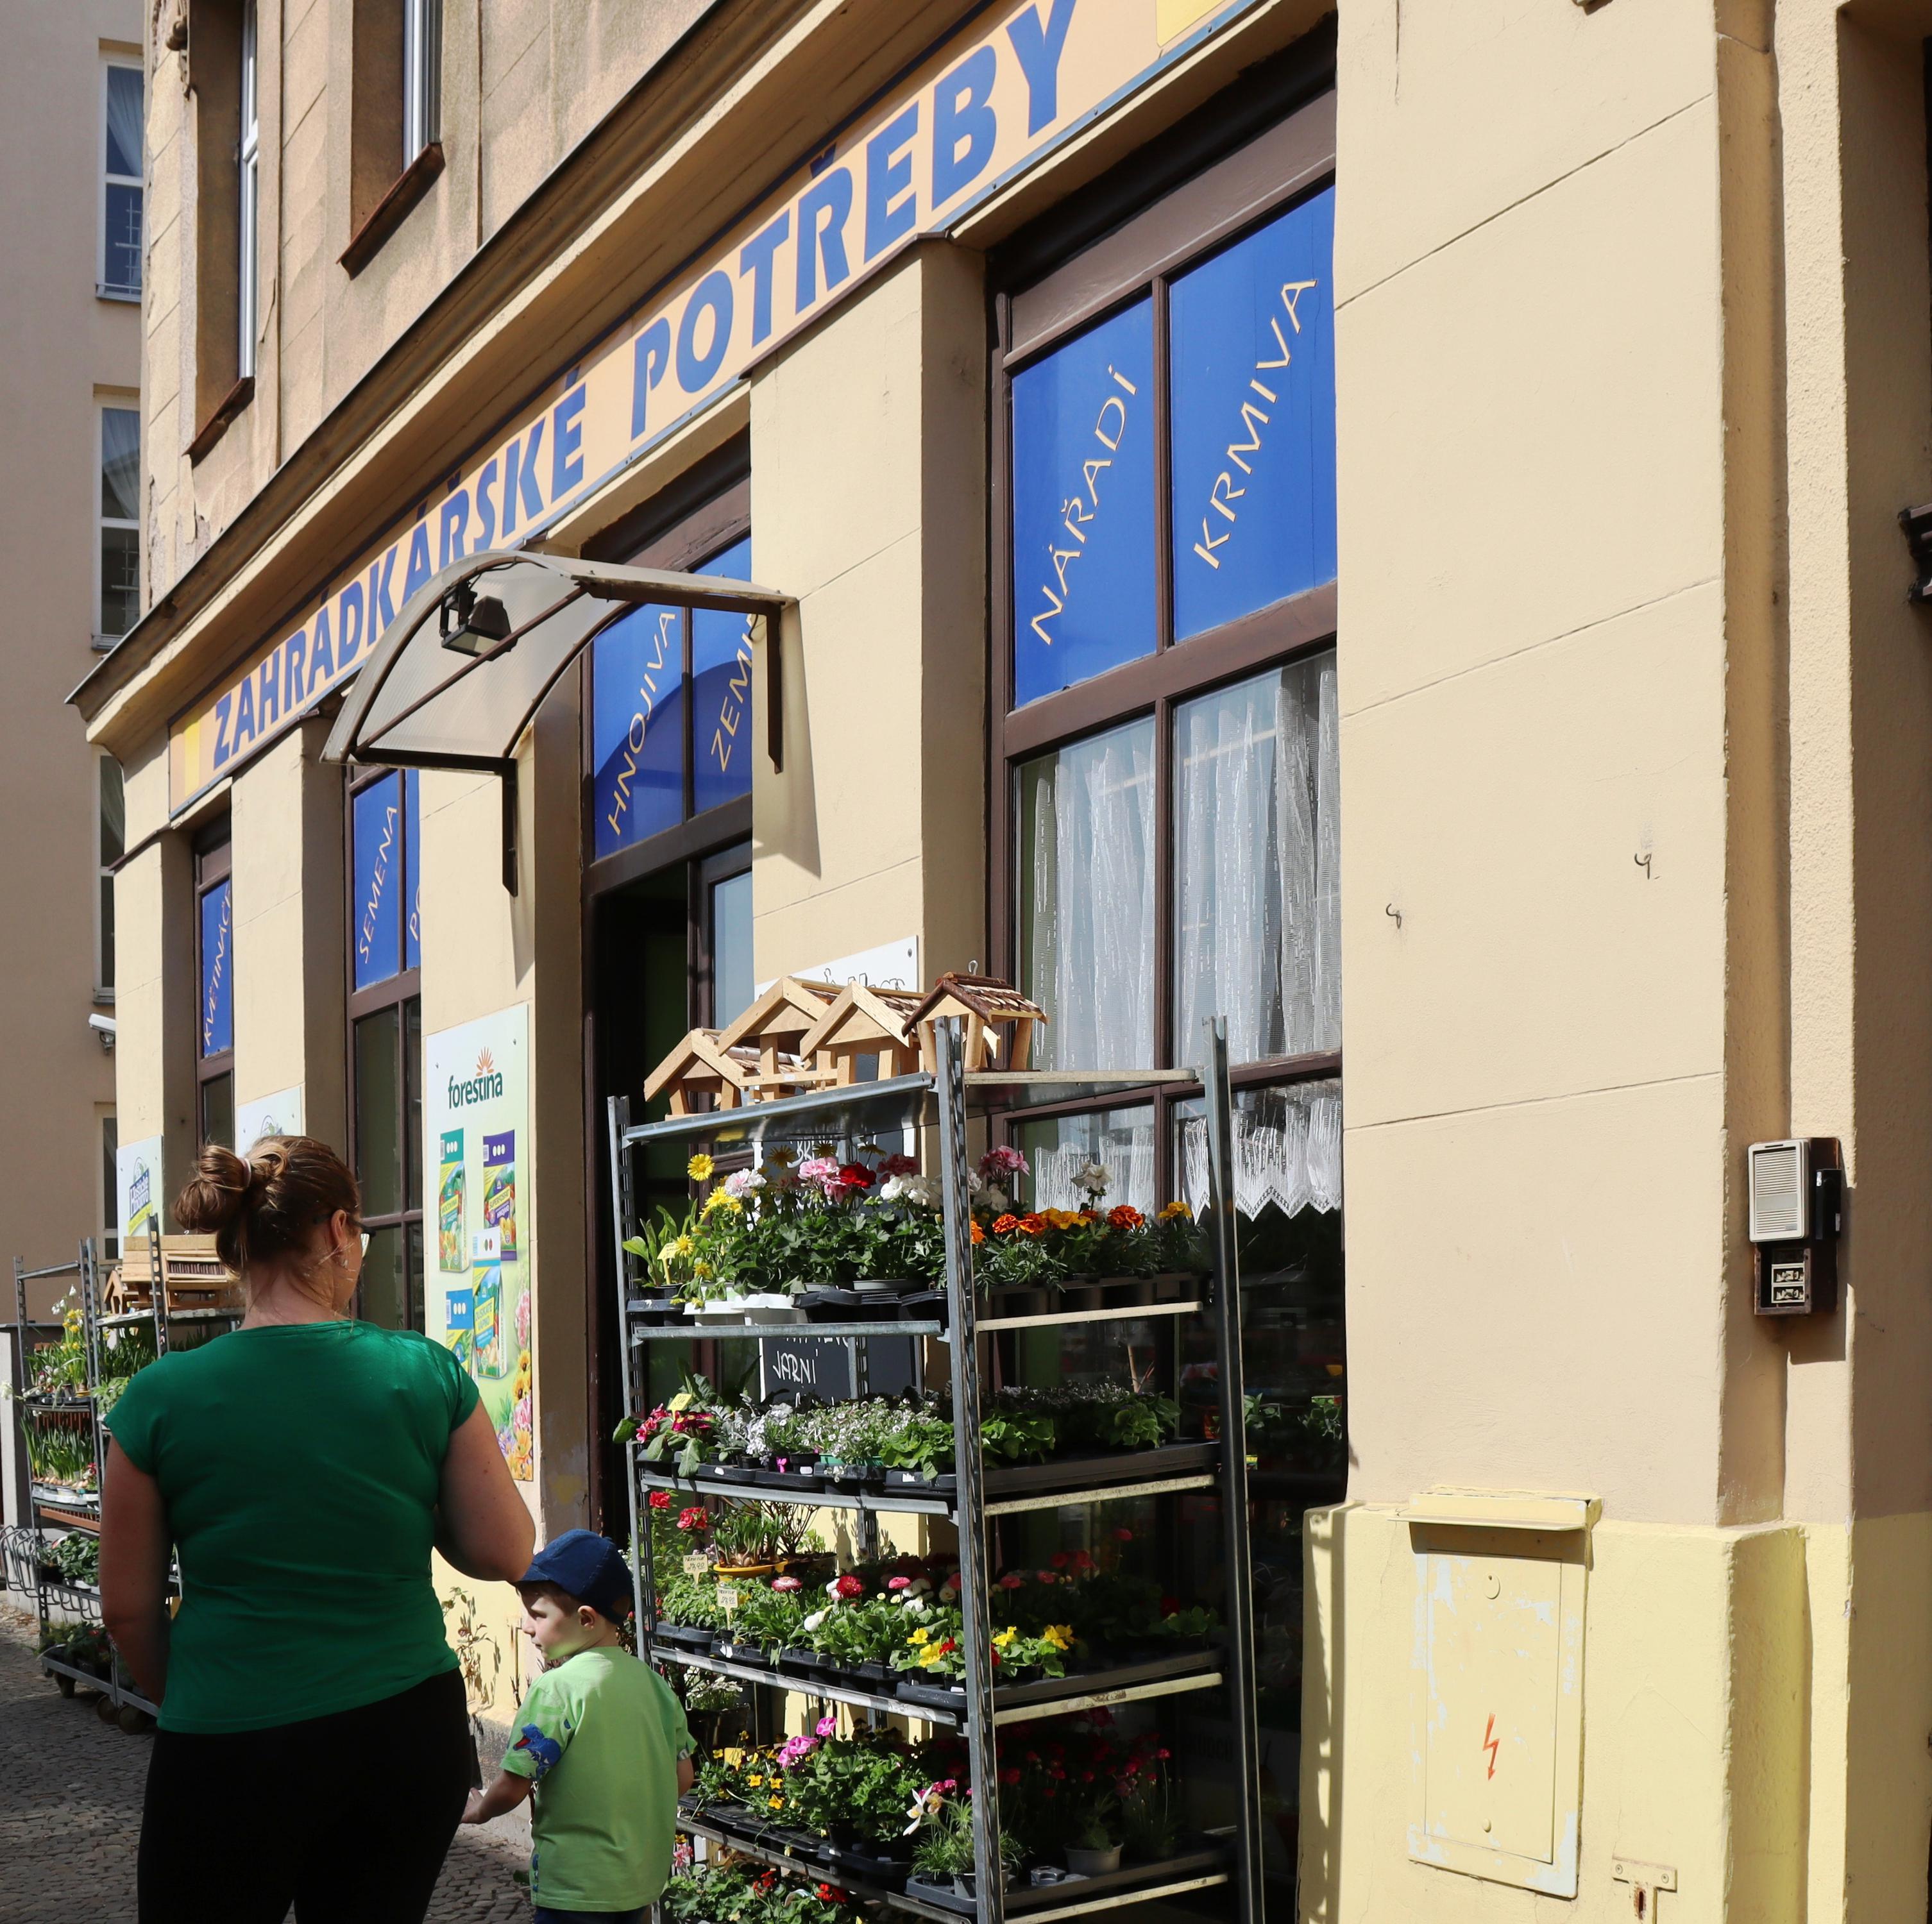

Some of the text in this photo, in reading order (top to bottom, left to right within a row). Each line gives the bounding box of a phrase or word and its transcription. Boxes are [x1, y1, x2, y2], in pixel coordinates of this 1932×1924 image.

[214, 0, 1077, 770] ZAHRÁDKÁŘSKÉ POTŘEBY
[1030, 364, 1137, 645] NÁŘADÍ
[1193, 278, 1318, 570] KRMIVA
[607, 612, 677, 836] HNOJIVA
[359, 806, 397, 964] SEMENA
[448, 1072, 503, 1110] forestina
